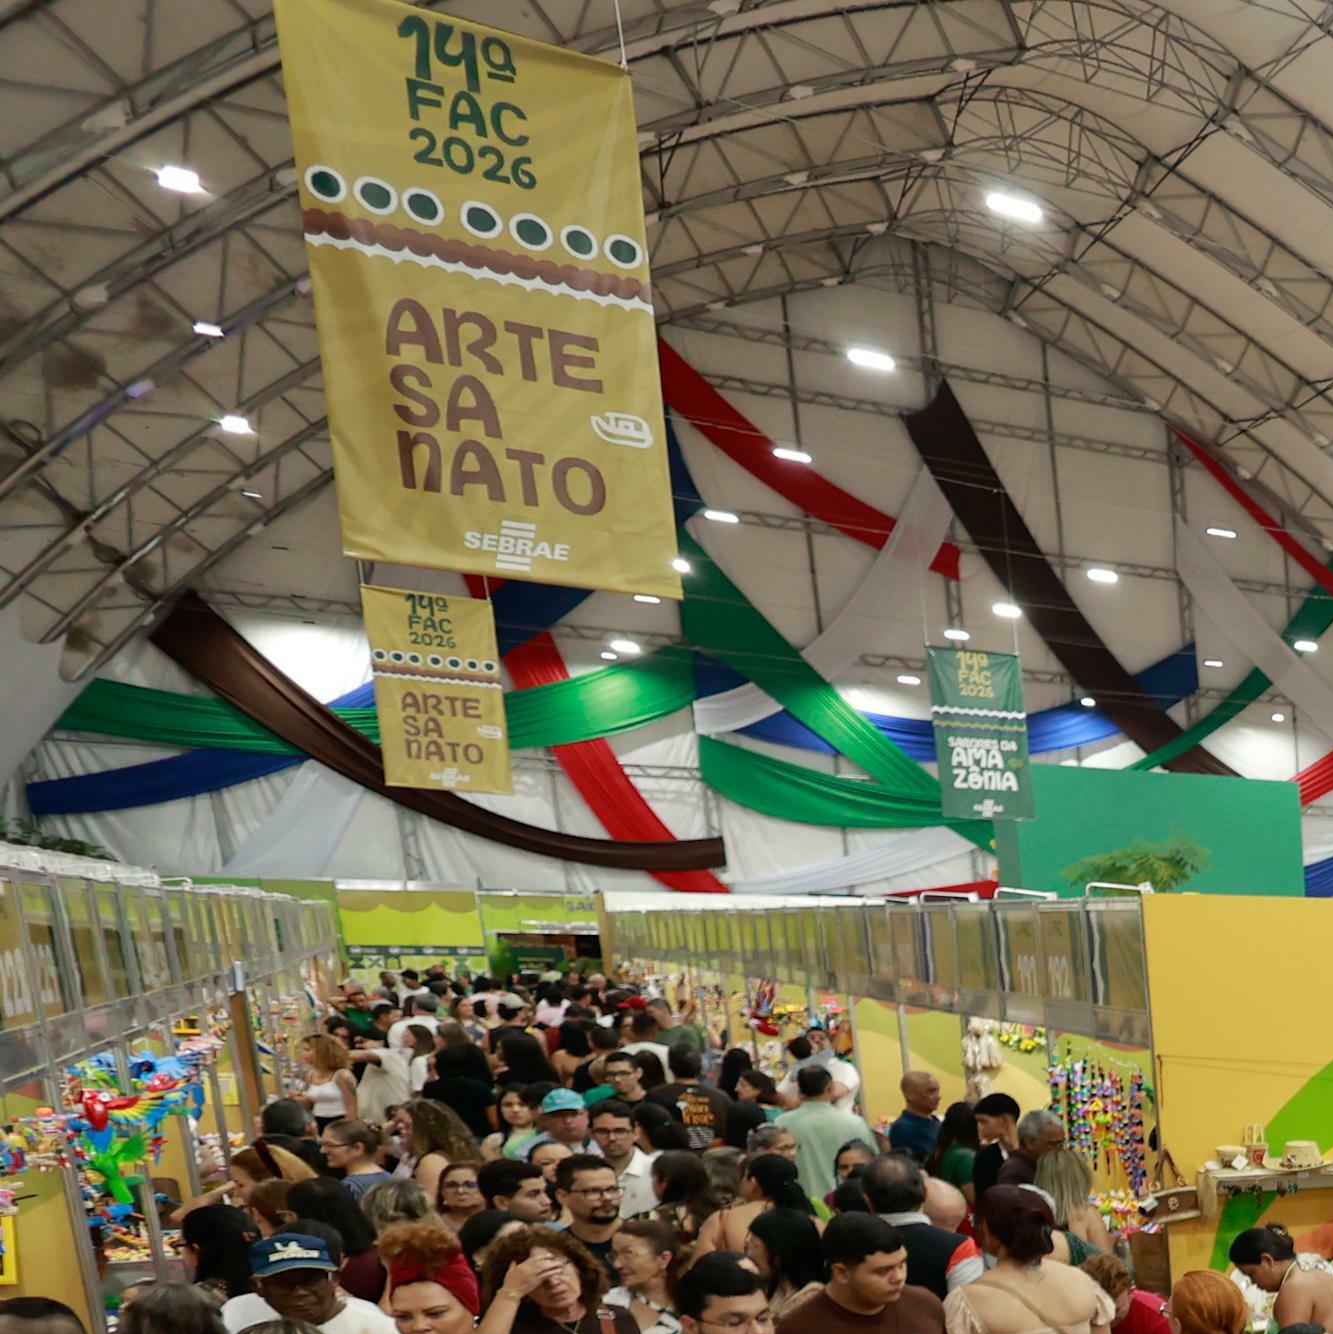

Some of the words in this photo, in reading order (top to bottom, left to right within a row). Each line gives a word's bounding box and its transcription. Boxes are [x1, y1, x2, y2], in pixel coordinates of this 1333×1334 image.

[406, 78, 530, 147] FAC
[409, 128, 537, 190] 2026
[386, 297, 603, 393] ARTE
[389, 364, 502, 439] SA
[464, 530, 570, 562] SEBRAE
[409, 614, 453, 635] FAC
[409, 631, 456, 649] 2026
[958, 670, 992, 686] FAC
[960, 684, 995, 698] 2026
[401, 691, 482, 719] ARTE
[404, 714, 444, 739] SA
[947, 736, 998, 750] SABORES
[1000, 739, 1018, 752] DA
[951, 748, 1004, 769] AMA
